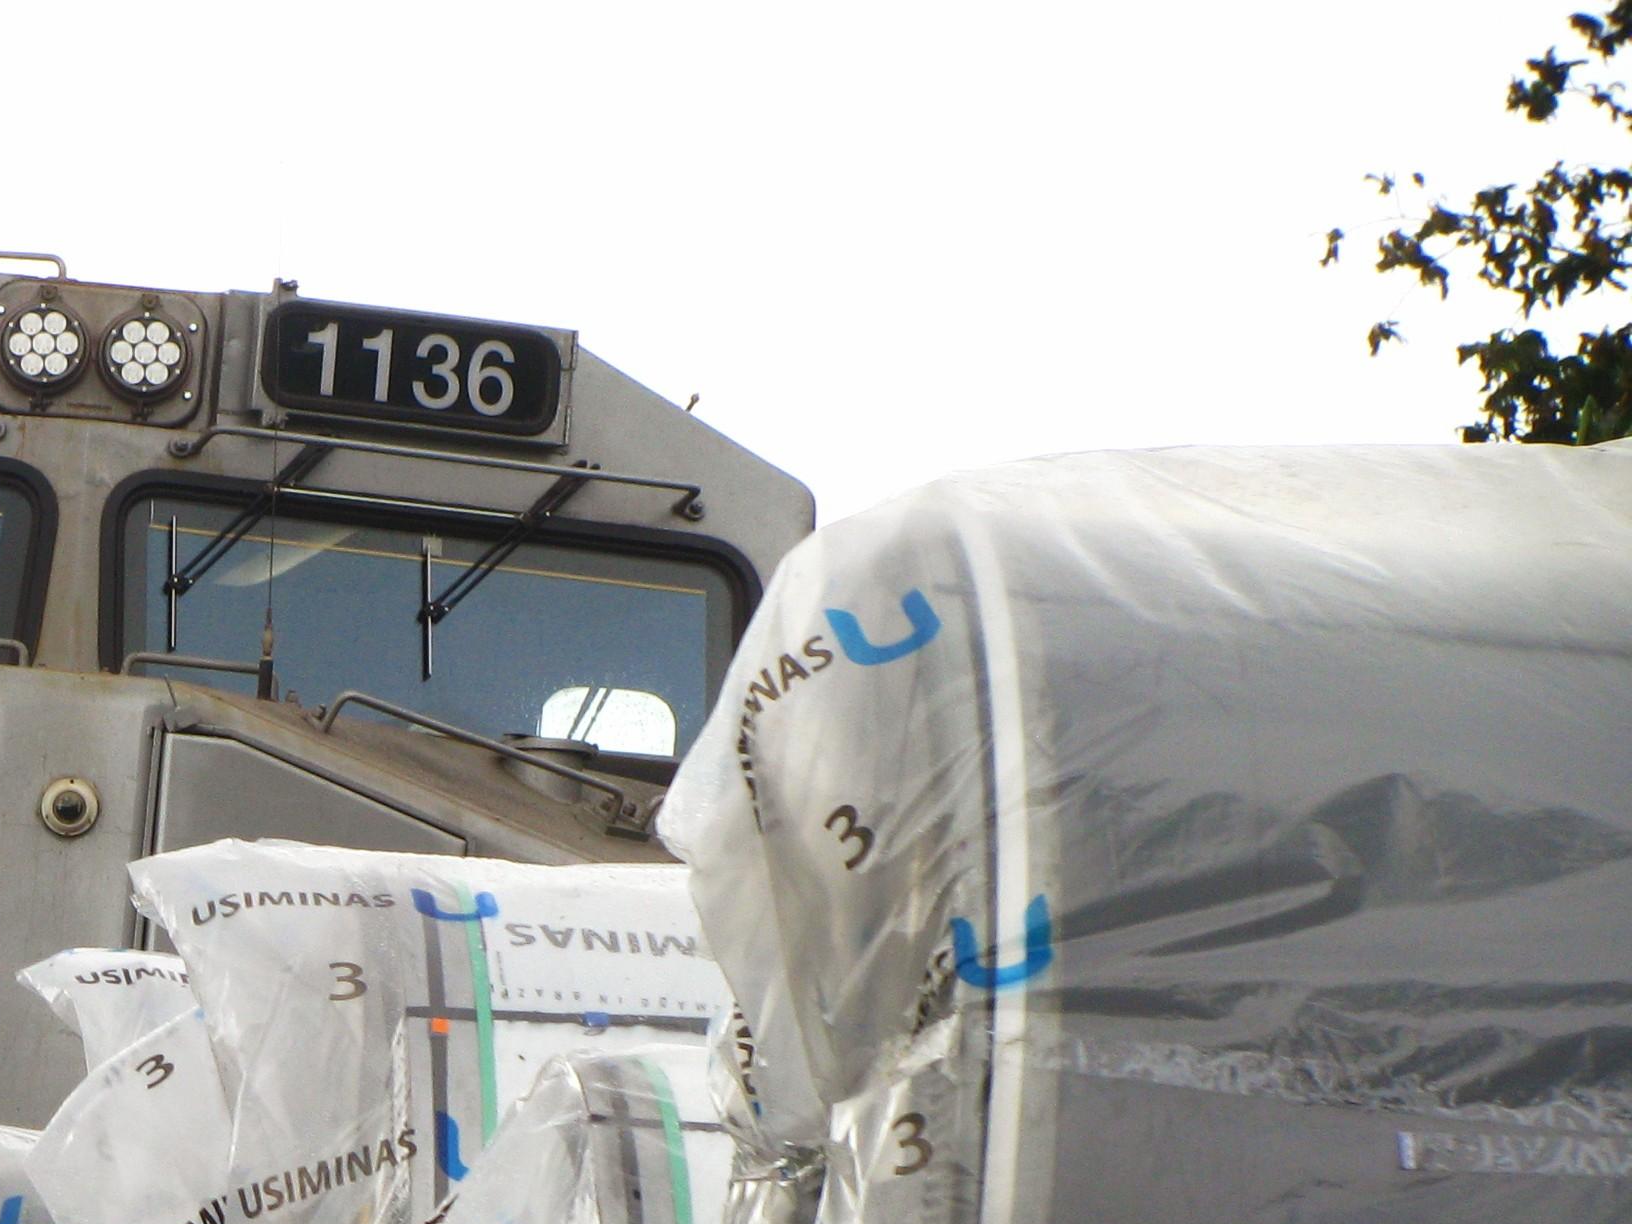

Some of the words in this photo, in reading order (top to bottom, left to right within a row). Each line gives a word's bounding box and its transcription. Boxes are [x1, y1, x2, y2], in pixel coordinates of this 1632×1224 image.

[306, 321, 519, 416] 1136
[825, 804, 875, 870] 3
[192, 891, 395, 926] USIMINAS
[328, 961, 368, 1001] 3
[135, 1052, 175, 1089] 3
[238, 1129, 418, 1220] USIMINAS
[891, 1111, 934, 1176] 3
